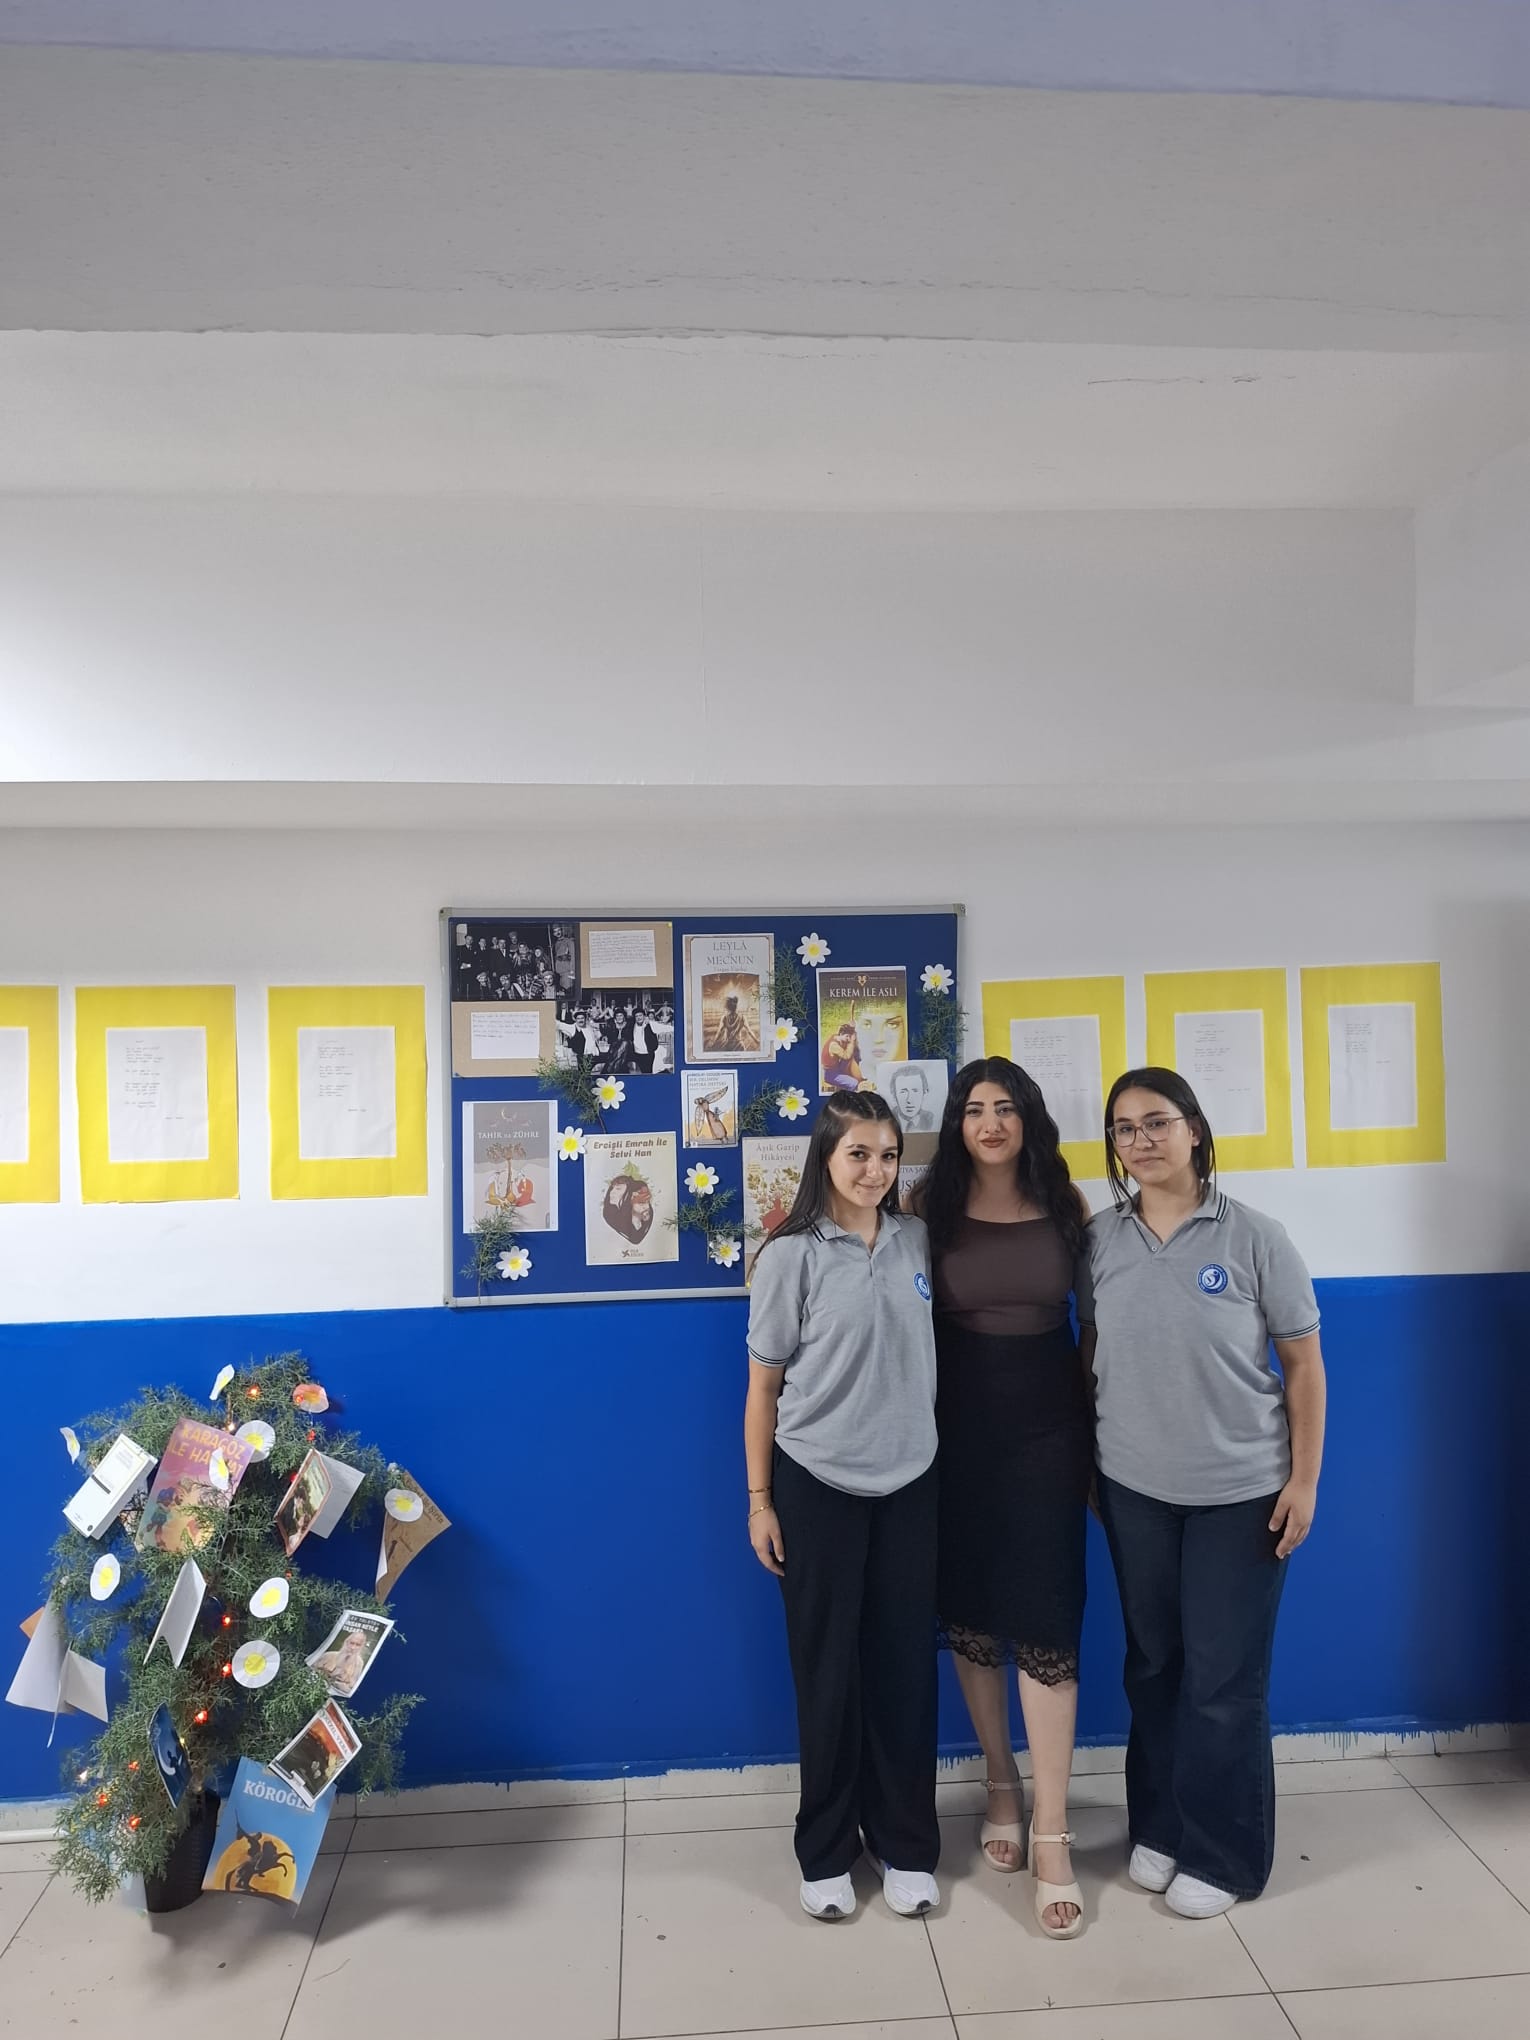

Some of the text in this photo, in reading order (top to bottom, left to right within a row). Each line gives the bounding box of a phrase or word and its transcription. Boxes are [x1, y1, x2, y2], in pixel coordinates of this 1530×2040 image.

[829, 988, 860, 998] KEREM
[878, 986, 897, 997] ASLI
[593, 1140, 623, 1150] Ercişli
[625, 1138, 654, 1149] Emrah
[776, 1143, 800, 1153] Garip
[609, 1149, 652, 1159] Selvi Han
